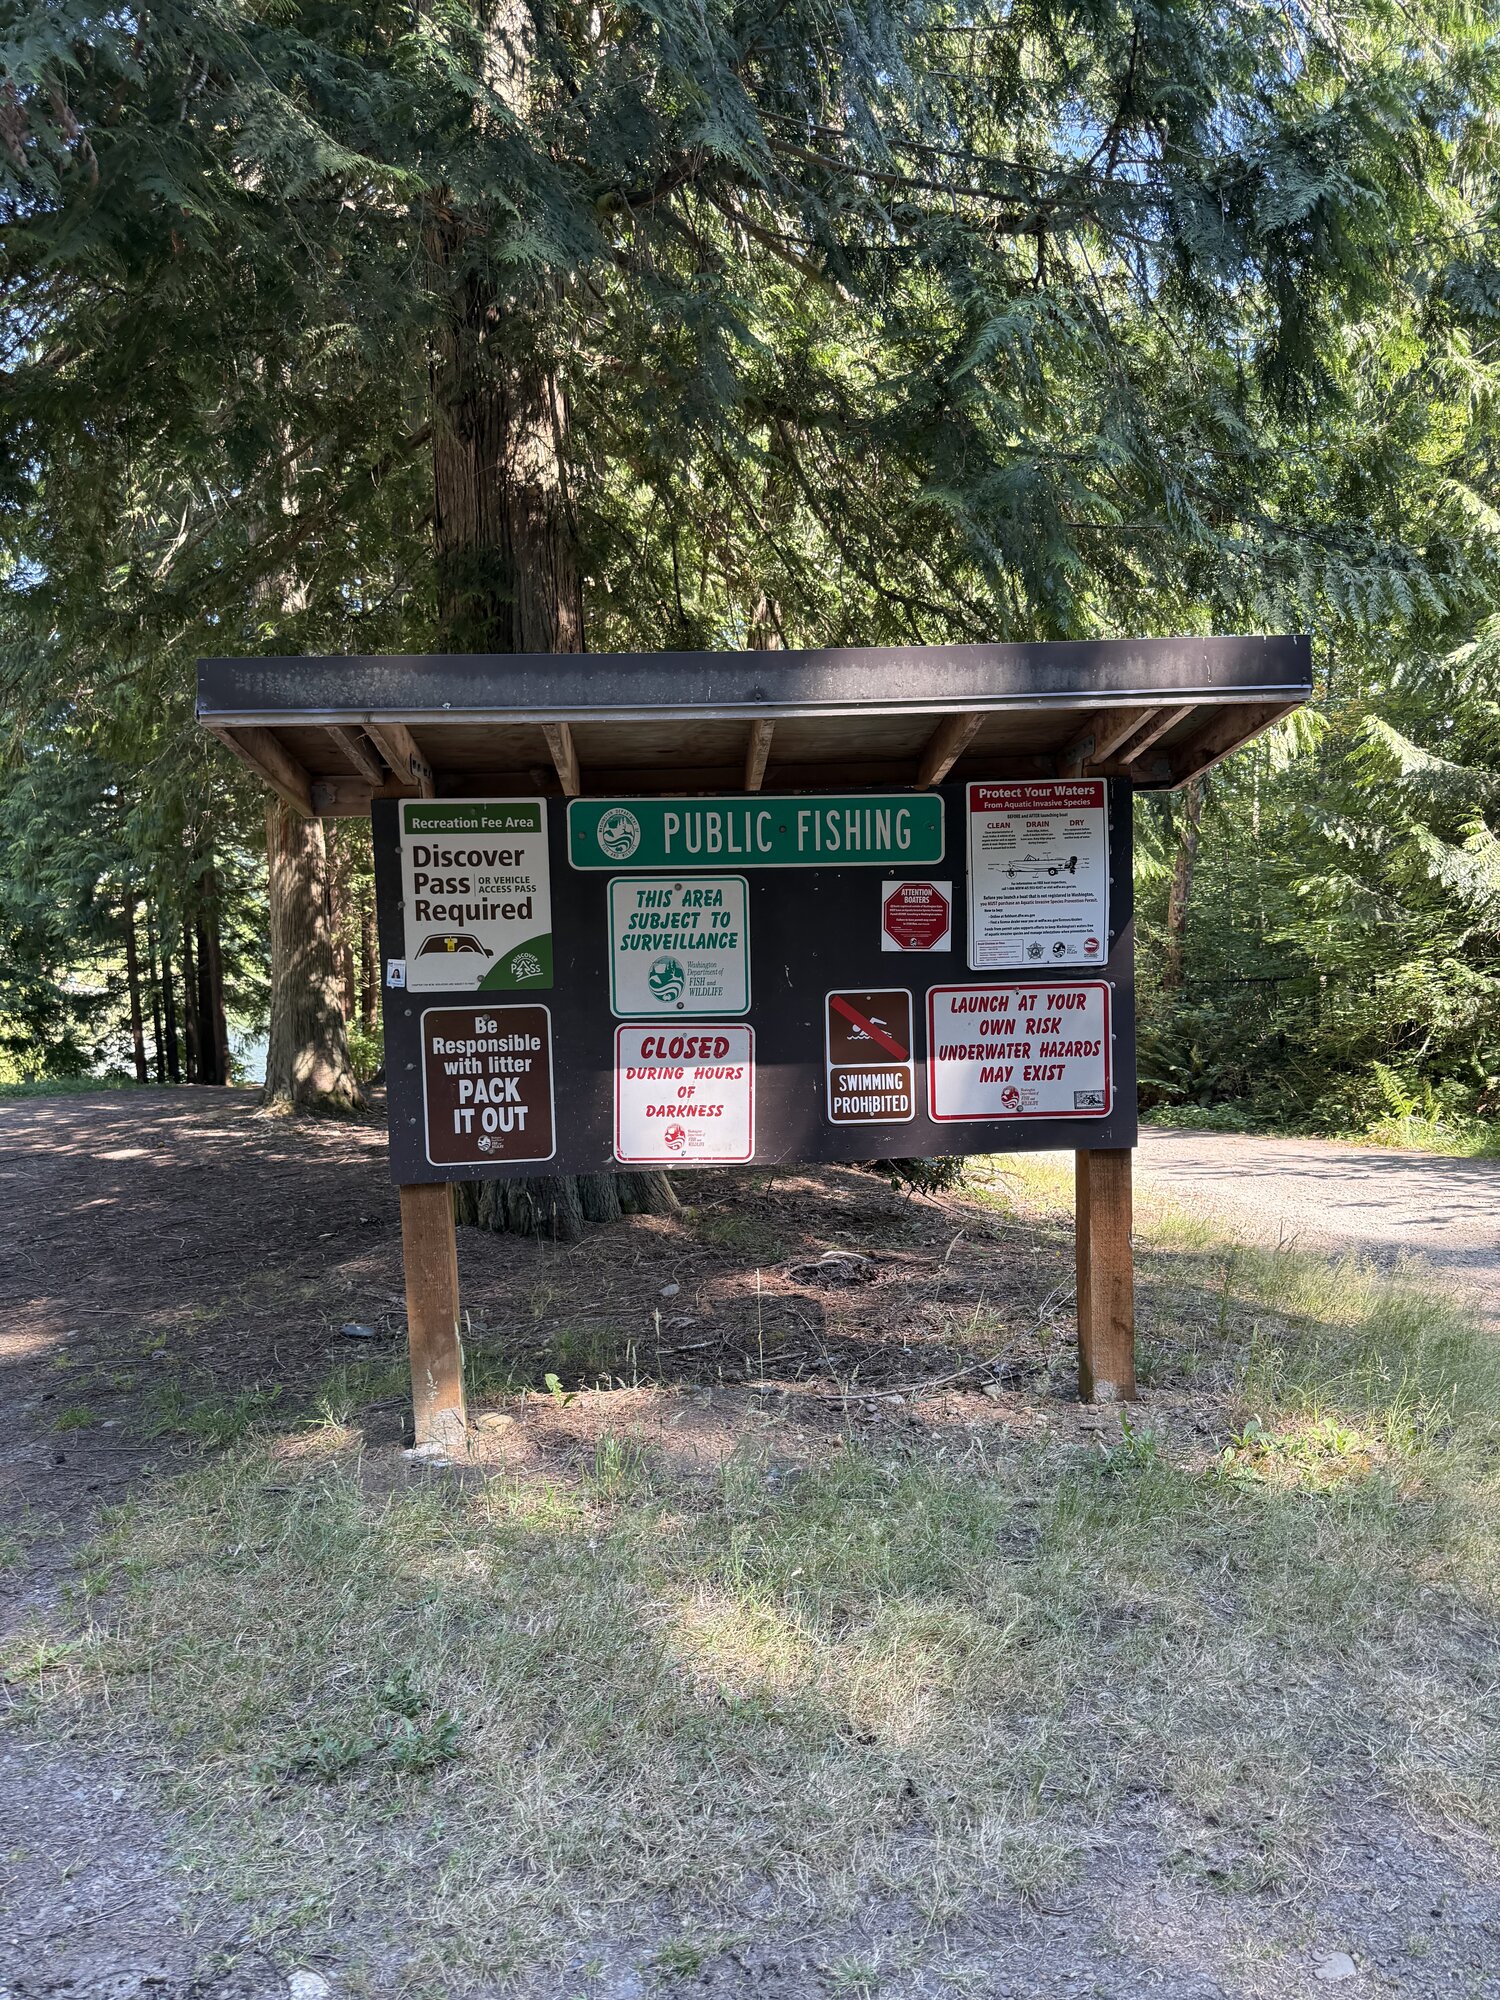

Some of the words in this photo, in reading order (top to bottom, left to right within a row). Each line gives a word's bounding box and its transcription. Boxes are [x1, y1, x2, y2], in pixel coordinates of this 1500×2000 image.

[979, 787, 1021, 798] Protect
[1024, 786, 1052, 797] Your
[1054, 785, 1096, 796] Waters
[984, 801, 1003, 809] From
[1004, 800, 1031, 809] Aquatic
[1033, 799, 1063, 807] Invasive
[1063, 798, 1091, 807] Species
[412, 817, 479, 829] Recreation
[481, 816, 502, 828] Fee
[505, 816, 534, 828] Area
[664, 811, 773, 854] PUBLIC
[797, 808, 911, 851] FISHING
[1026, 820, 1050, 828] DRAIN
[1069, 819, 1085, 827] DRY
[412, 843, 525, 868] Discover
[414, 872, 471, 895] Pass
[478, 877, 491, 885] OR
[493, 876, 530, 884] VEHICLE
[478, 885, 512, 894] ACCESS
[514, 885, 537, 893] PASS
[636, 889, 673, 908] THIS
[681, 889, 723, 908] AREA
[901, 888, 933, 896] ATTENTION
[904, 896, 930, 904] BOATERS
[415, 896, 533, 927] Required
[628, 912, 701, 930] SUBJECT
[710, 911, 731, 929] TO
[620, 932, 739, 952] SURVEILLANCE
[512, 952, 538, 963] DISCOVER
[687, 960, 717, 969] Washington
[687, 968, 718, 977] Department
[718, 967, 725, 977] of
[689, 977, 706, 987] FISH
[689, 986, 724, 997] WILDLIFE
[950, 995, 1010, 1014] LAUNCH
[1018, 994, 1038, 1012] AT
[1047, 993, 1087, 1011] YOUR
[474, 1016, 498, 1034] Be
[979, 1018, 1016, 1036] OWN
[1025, 1017, 1062, 1036] RISK
[432, 1033, 541, 1057] Responsible
[640, 1036, 730, 1059] CLOSED
[939, 1042, 1031, 1062] UNDERWATER
[1039, 1039, 1101, 1058] HAZARDS
[444, 1057, 483, 1075] with
[488, 1056, 532, 1074] litter
[626, 1067, 685, 1081] DURING
[693, 1067, 744, 1081] HOURS
[979, 1066, 1014, 1083] MAY
[1022, 1064, 1066, 1082] EXIST
[458, 1076, 522, 1105] PACK
[839, 1072, 903, 1092] SWIMMING
[677, 1085, 696, 1099] OF
[453, 1108, 475, 1134] IT
[481, 1105, 529, 1133] OUT
[645, 1104, 724, 1119] DARKNESS
